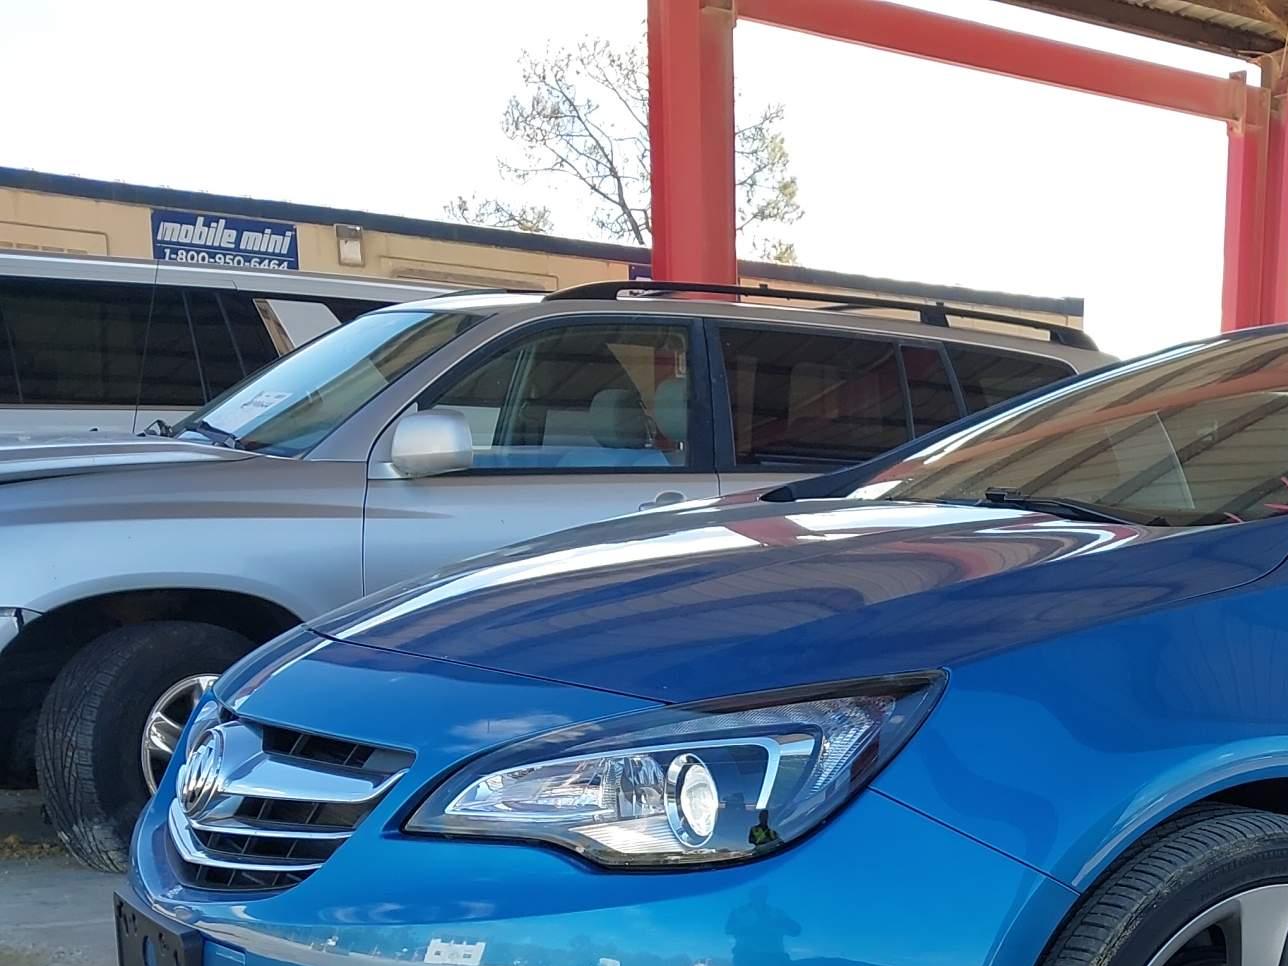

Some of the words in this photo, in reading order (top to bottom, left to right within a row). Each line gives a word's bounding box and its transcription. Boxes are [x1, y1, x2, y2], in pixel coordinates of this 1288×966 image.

[157, 216, 236, 248] mobile
[240, 229, 291, 254] mini
[163, 249, 289, 269] 1-800-950-6464
